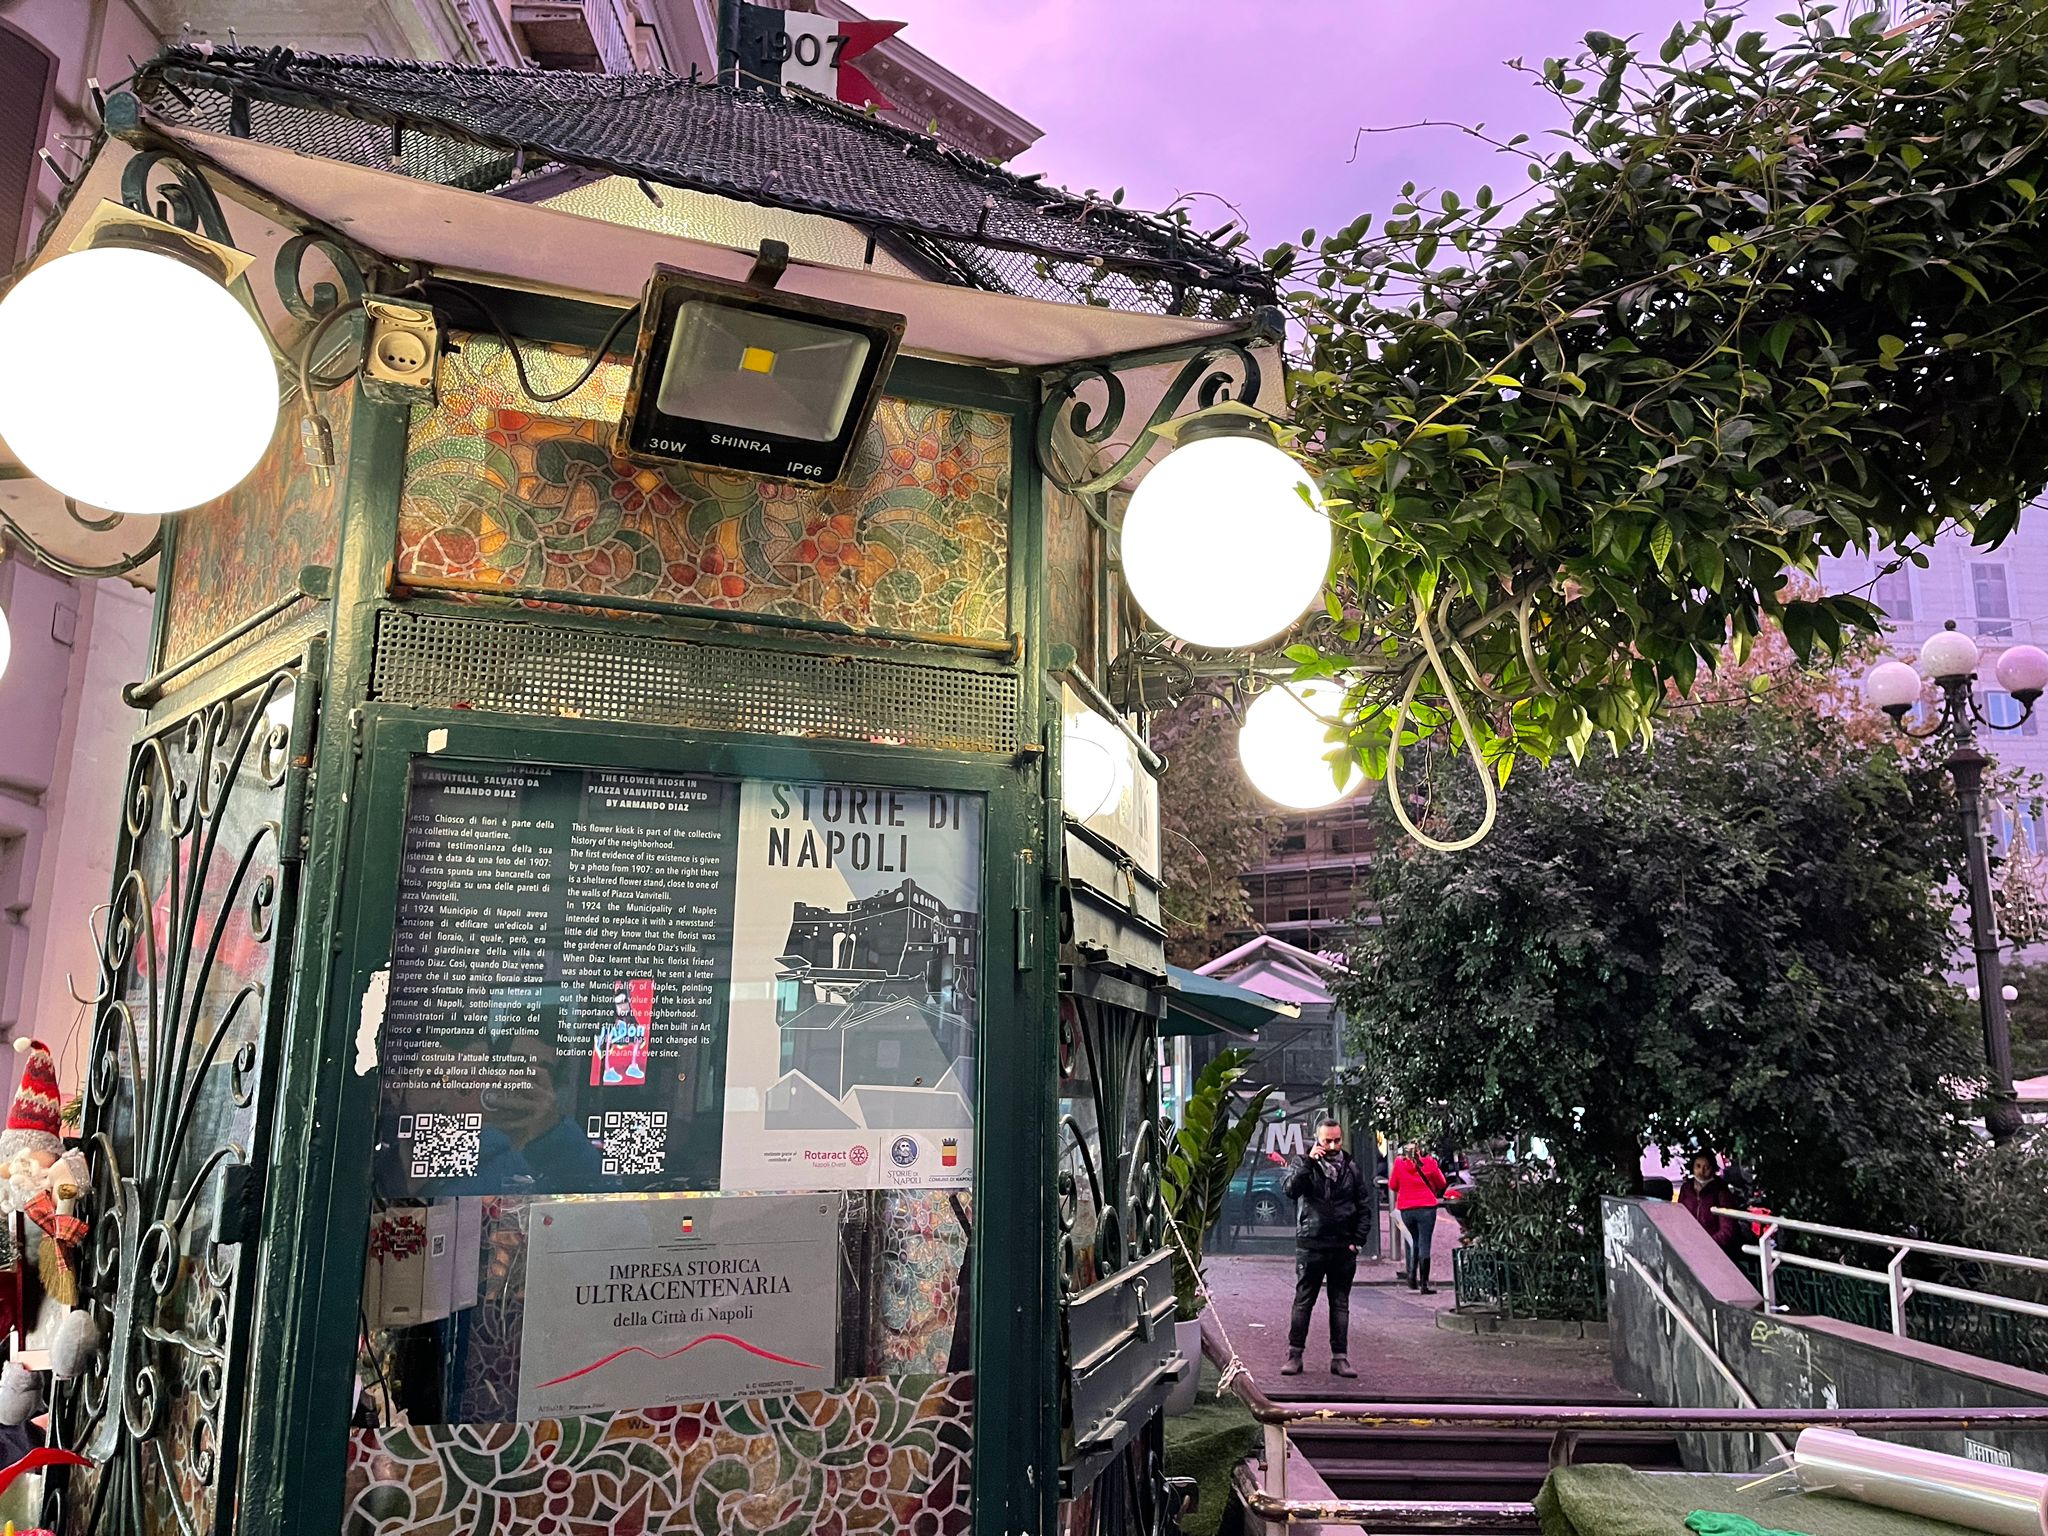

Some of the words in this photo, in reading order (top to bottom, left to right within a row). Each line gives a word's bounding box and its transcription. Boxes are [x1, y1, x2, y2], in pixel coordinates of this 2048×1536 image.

[756, 31, 849, 69] 1907
[649, 438, 687, 453] 30W
[710, 434, 771, 453] SHINRA
[787, 461, 822, 476] IP66
[483, 775, 525, 786] SALVATO
[527, 778, 540, 787] DA
[600, 773, 617, 783] THE
[619, 775, 655, 785] FLOWER
[657, 777, 685, 787] KIOSK
[687, 779, 697, 788] IN
[443, 786, 492, 797] ARMANDO
[493, 788, 517, 798] DIAZ
[588, 785, 621, 795] PIAZZA
[622, 787, 677, 800] VANVITELLI,
[679, 790, 708, 801] SAVED
[605, 799, 619, 808] BY
[619, 799, 666, 811] ARMANDO
[668, 802, 690, 812] DIAZ
[771, 784, 905, 827] STORIE
[929, 794, 960, 830] DI
[571, 823, 587, 832] This
[589, 824, 613, 834] flower
[615, 825, 635, 835] kiosk
[637, 826, 644, 835] is
[646, 827, 661, 838] part
[663, 828, 671, 837] of
[673, 828, 686, 838] the
[688, 829, 722, 840] collective
[571, 835, 597, 847] history
[598, 837, 607, 846] of
[607, 837, 620, 846] the
[621, 838, 675, 849] neighborhood.
[570, 848, 584, 858] The
[585, 849, 600, 858] first
[601, 850, 635, 860] evidence
[636, 851, 645, 860] of
[645, 852, 655, 861] its
[656, 852, 690, 862] existence
[692, 854, 698, 863] is
[700, 854, 720, 865] given
[768, 827, 908, 873] NAPOLI
[569, 862, 579, 873] by
[587, 863, 610, 873] photo
[611, 863, 629, 873] from
[631, 864, 653, 874] 1907:
[667, 866, 679, 875] the
[681, 866, 699, 878] right
[700, 867, 720, 877] there
[568, 874, 575, 883] is
[582, 875, 617, 885] sheltered
[619, 876, 642, 886] flower
[643, 877, 666, 888] stand,
[667, 878, 685, 888] close
[687, 879, 695, 888] to
[695, 881, 709, 889] one
[711, 880, 719, 889] of
[567, 887, 580, 897] the
[581, 888, 601, 897] walls
[602, 889, 611, 898] of
[611, 889, 634, 899] Piazza
[635, 890, 672, 900] Vanvitelli.
[566, 900, 575, 909] In
[581, 901, 601, 910] 1924
[607, 902, 620, 911] the
[626, 902, 673, 915] Municipality
[678, 905, 687, 914] of
[692, 905, 717, 917] Naples
[565, 914, 600, 924] intended
[602, 915, 610, 924] to
[612, 916, 640, 927] replace
[641, 916, 648, 925] it
[649, 917, 666, 926] with
[675, 918, 716, 927] newsstand:
[564, 927, 582, 936] little
[585, 928, 598, 937] did
[601, 928, 619, 940] they
[621, 929, 641, 938] know
[644, 929, 660, 939] that
[662, 930, 675, 939] the
[677, 930, 699, 940] florist
[563, 940, 577, 949] the
[577, 941, 612, 952] gardener
[613, 942, 622, 950] of
[622, 942, 656, 951] Armando
[657, 943, 679, 952] Diaz's
[680, 943, 698, 953] villa.
[562, 953, 585, 963] When
[589, 954, 606, 963] Diaz
[608, 955, 631, 964] learnt
[634, 955, 650, 964] that
[653, 956, 665, 965] his
[668, 956, 689, 966] florist
[692, 957, 715, 966] friend
[578, 967, 601, 976] about
[603, 968, 611, 977] to
[613, 968, 624, 977] be
[625, 968, 655, 979] evicted,
[657, 969, 667, 978] he
[669, 969, 685, 978] sent
[694, 970, 714, 979] letter
[560, 980, 569, 989] to
[572, 980, 585, 989] the
[681, 983, 713, 994] pointing
[559, 994, 573, 1003] out
[575, 994, 588, 1003] the
[651, 995, 659, 1004] of
[661, 995, 674, 1004] the
[676, 996, 696, 1005] kiosk
[697, 996, 712, 1005] and
[558, 1007, 569, 1015] its
[571, 1007, 615, 1018] importance
[643, 1008, 699, 1019] neighborhood.
[558, 1021, 572, 1030] The
[573, 1021, 600, 1030] current
[651, 1022, 669, 1031] then
[670, 1022, 688, 1031] built
[690, 1022, 699, 1031] in
[699, 1022, 711, 1031] Art
[556, 1034, 591, 1043] Nouveau
[650, 1035, 663, 1043] not
[665, 1035, 699, 1046] changed
[700, 1035, 710, 1044] its
[556, 1047, 586, 1056] location
[659, 1048, 681, 1057] since.
[1266, 1123, 1304, 1154] M
[804, 1150, 847, 1160] Rotaract
[887, 1170, 912, 1178] STORIE
[893, 1177, 921, 1185] NAPOLI
[609, 1263, 684, 1280] IMPRESA
[687, 1259, 761, 1275] STORICA
[575, 1275, 792, 1305] ULTRACENTENARIA
[613, 1310, 647, 1327] della
[651, 1309, 686, 1325] Città
[691, 1309, 704, 1322] di
[708, 1306, 754, 1324] Napoli
